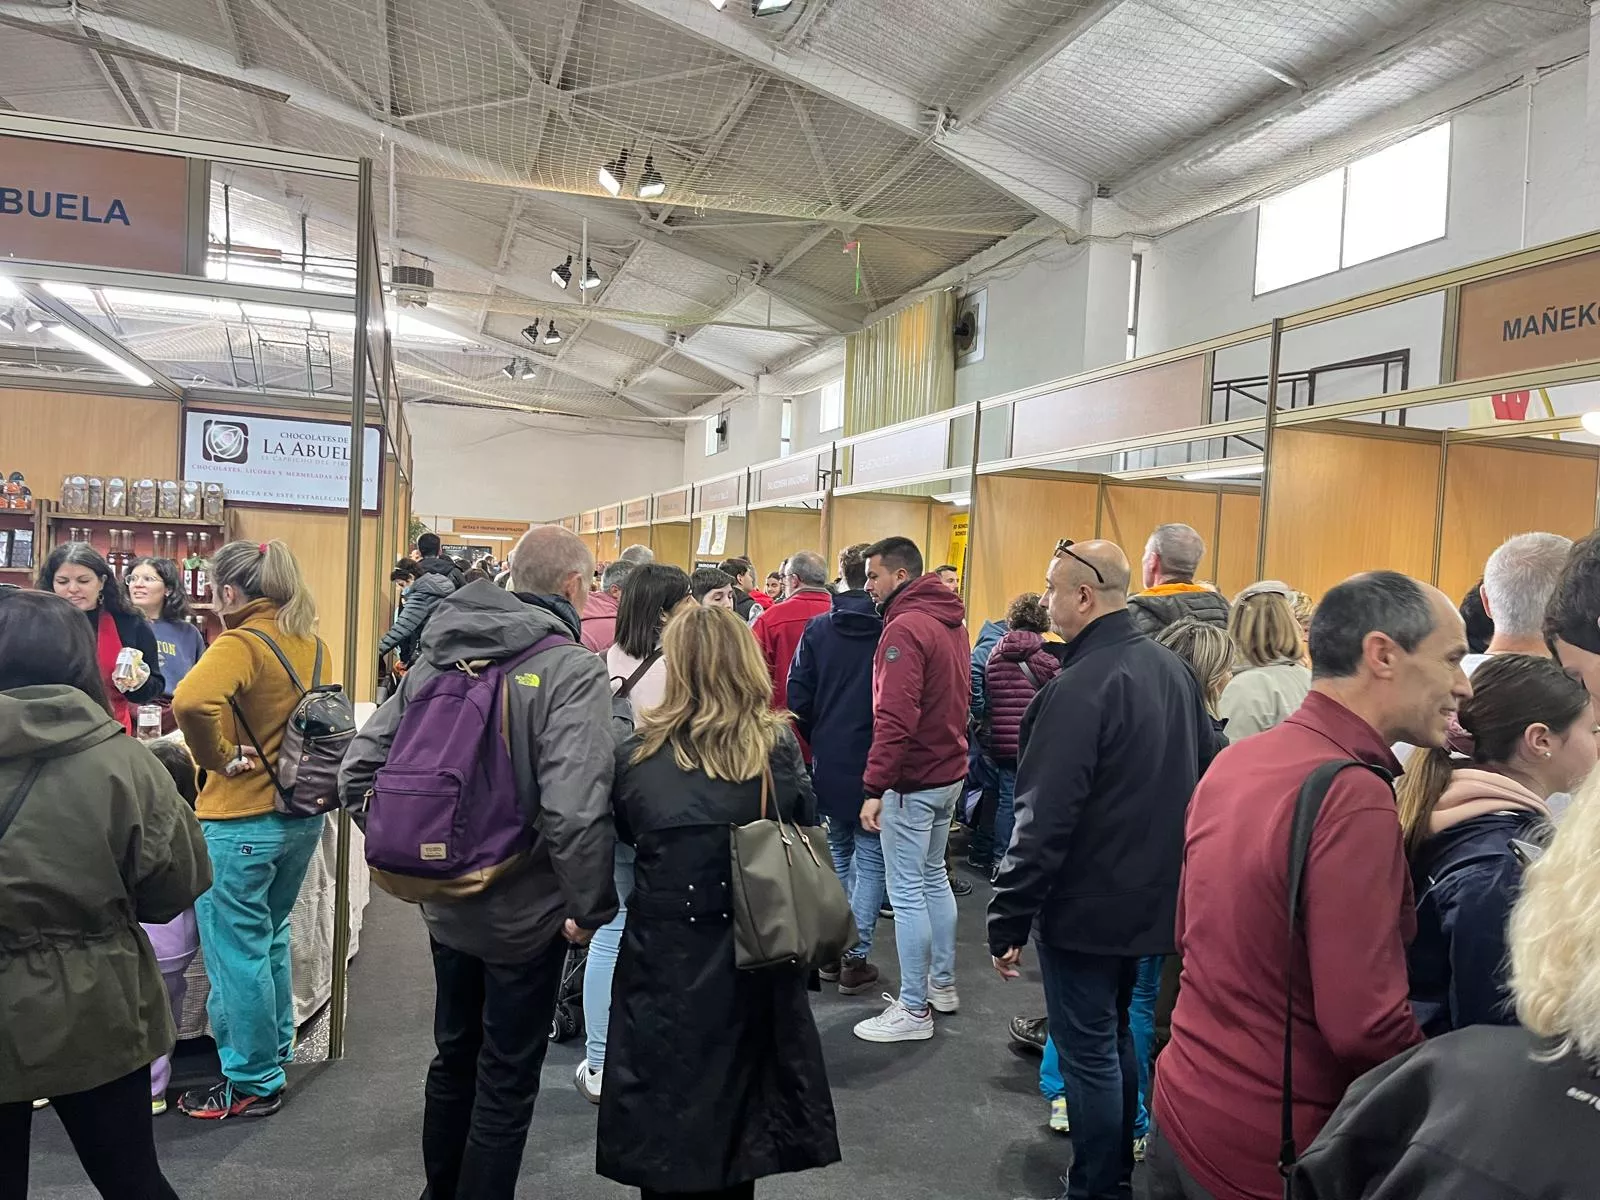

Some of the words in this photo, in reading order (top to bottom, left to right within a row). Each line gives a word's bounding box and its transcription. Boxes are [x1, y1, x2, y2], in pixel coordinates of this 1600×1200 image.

[1502, 302, 1600, 342] MAÑEK
[280, 431, 336, 442] CHOCOLATES
[337, 436, 349, 444] DE
[263, 438, 286, 456] LA
[291, 441, 351, 461] ABUEL
[245, 468, 275, 476] LICORES
[286, 470, 333, 480] MERMELADAS
[227, 488, 261, 497] DIRECTA
[276, 491, 294, 499] ESTE
